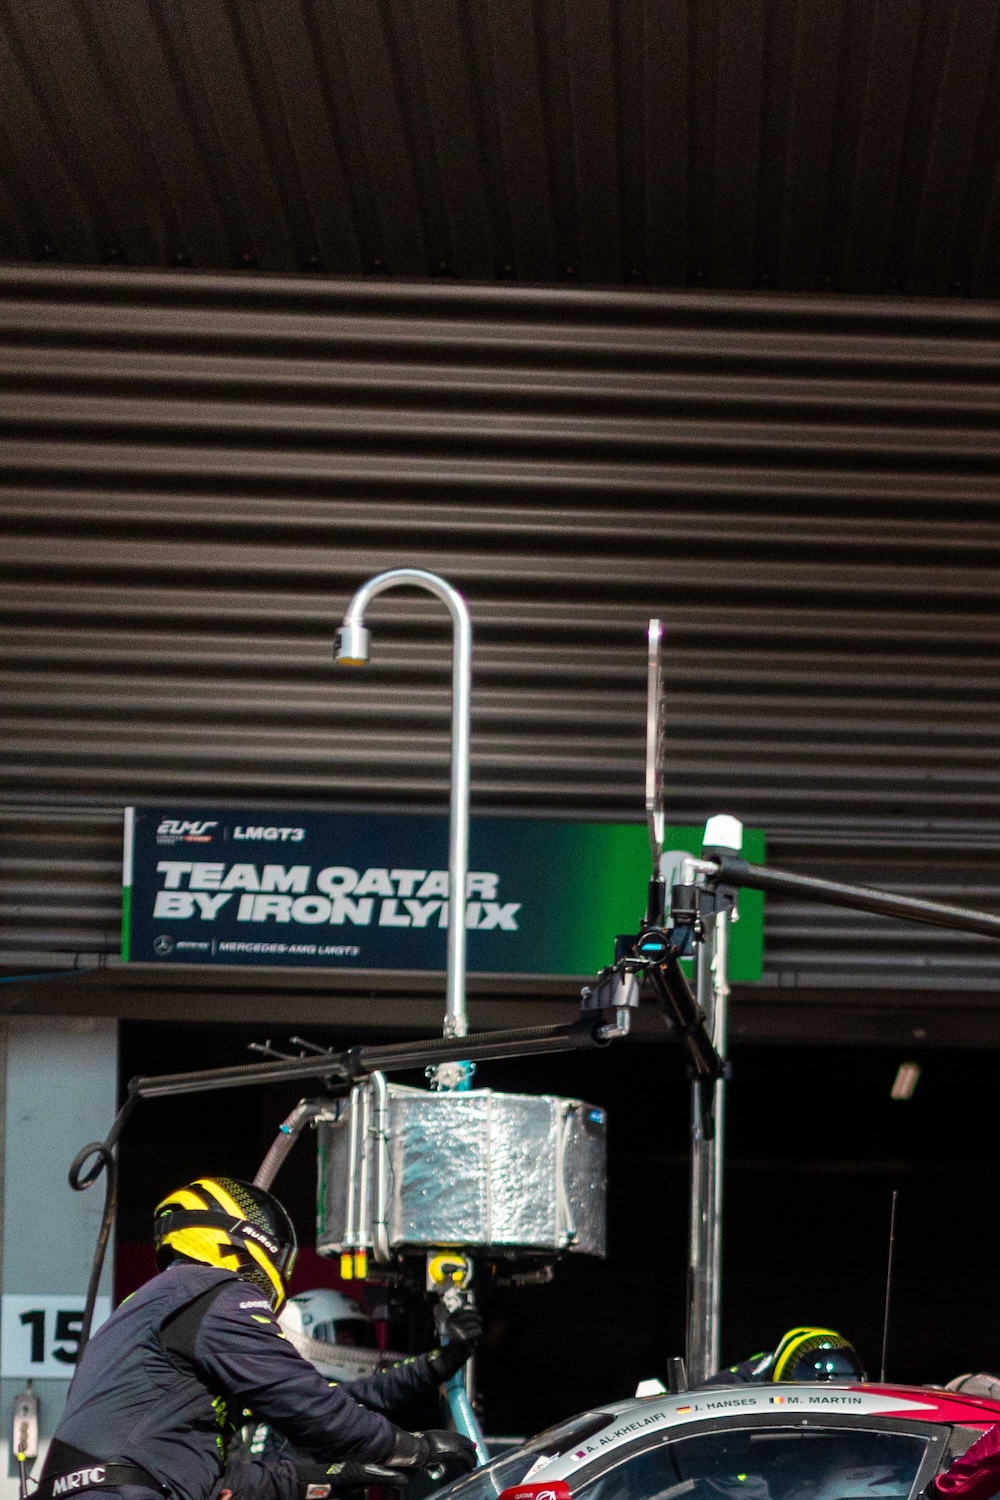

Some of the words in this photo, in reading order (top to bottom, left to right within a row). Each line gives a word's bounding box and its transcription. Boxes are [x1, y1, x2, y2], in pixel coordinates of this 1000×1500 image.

[233, 826, 305, 842] LMGT3
[156, 861, 311, 893] TEAM
[316, 866, 499, 900] QATAR
[153, 891, 233, 920] BY
[237, 893, 374, 925] IRON
[19, 1309, 86, 1364] 15
[707, 1398, 757, 1409] HANSES
[787, 1397, 803, 1405] M.
[808, 1397, 862, 1405] MARTIN
[586, 1445, 600, 1454] A.
[600, 1412, 667, 1446] AL-KHELAIFI
[52, 1467, 106, 1498] MRTC
